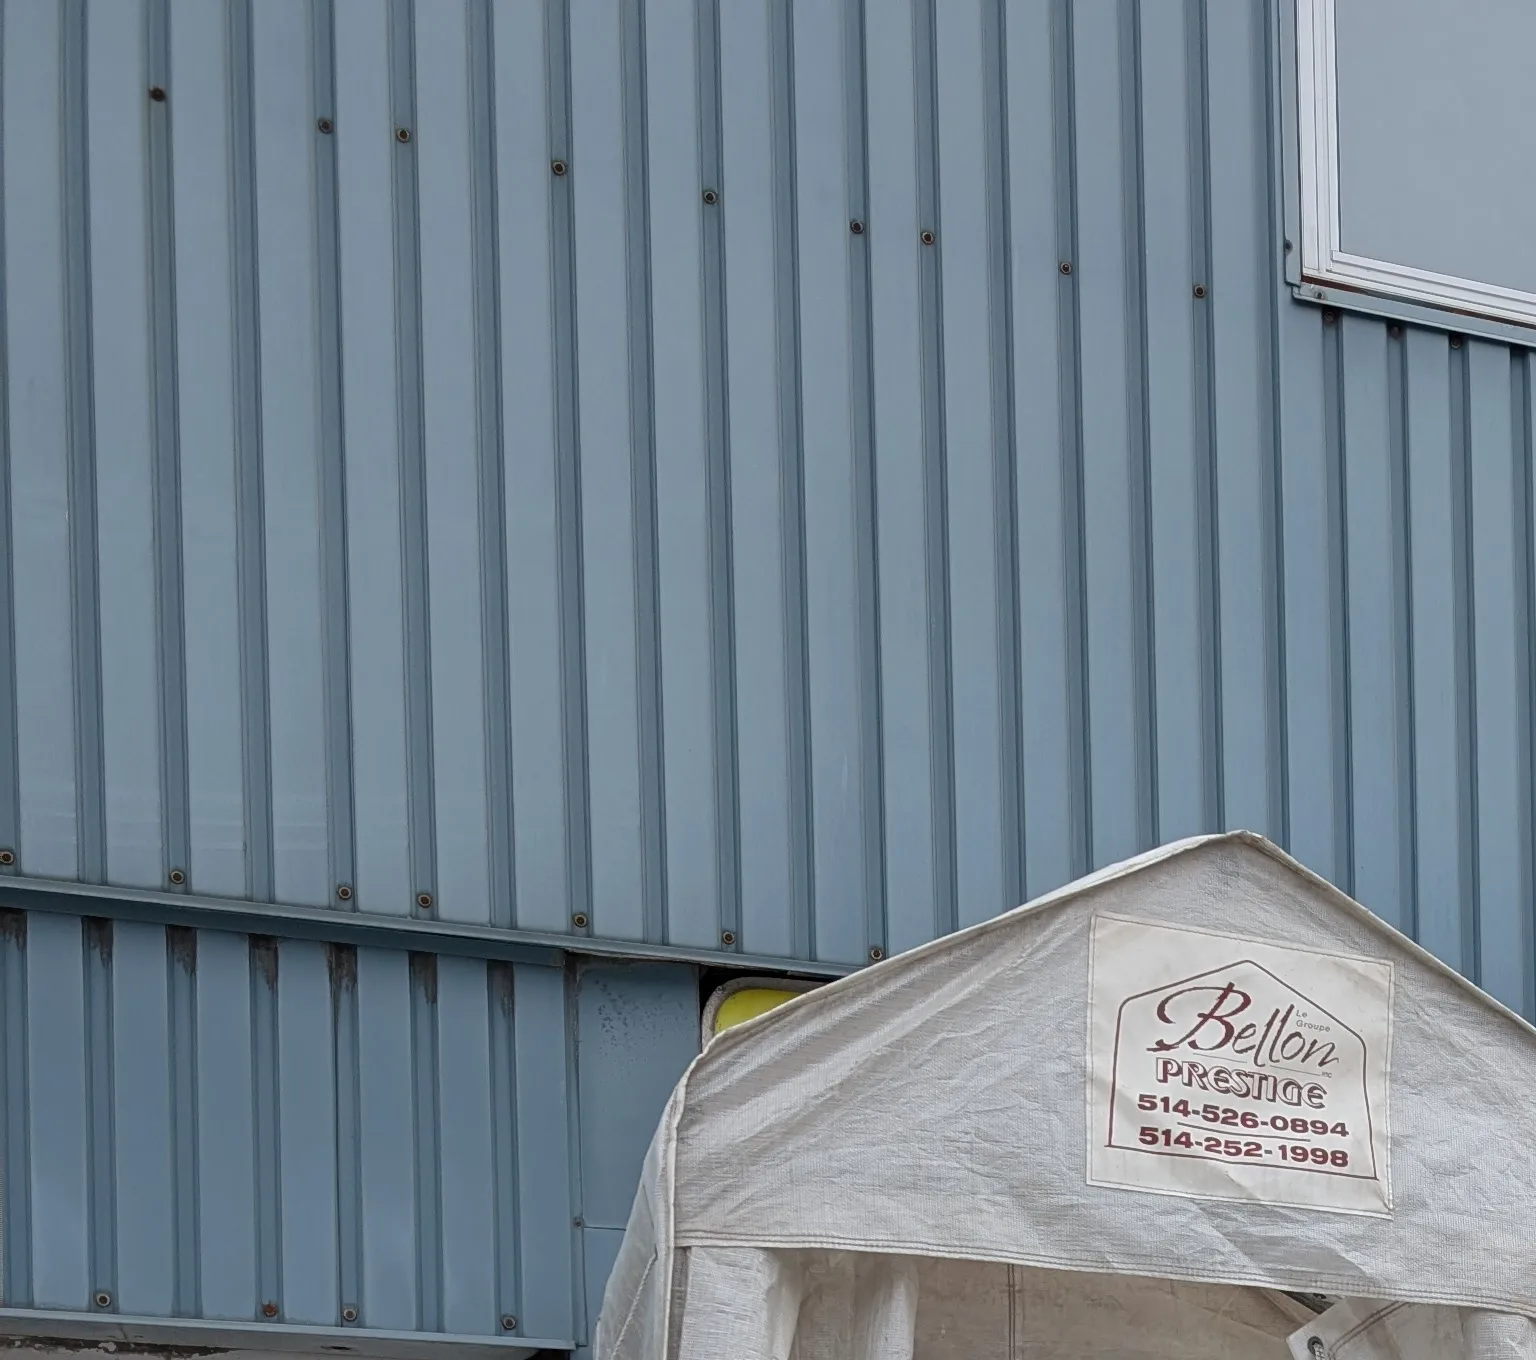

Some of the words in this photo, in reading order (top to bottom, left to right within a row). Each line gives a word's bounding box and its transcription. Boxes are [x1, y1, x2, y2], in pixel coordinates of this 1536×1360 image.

[1146, 982, 1340, 1068] Bellon
[1296, 1009, 1308, 1018] Le
[1296, 1019, 1331, 1032] Groupe
[1156, 1057, 1328, 1109] PRESTIGE
[1137, 1093, 1349, 1137] 514-526-0894
[1138, 1126, 1349, 1168] 514-252-1998
